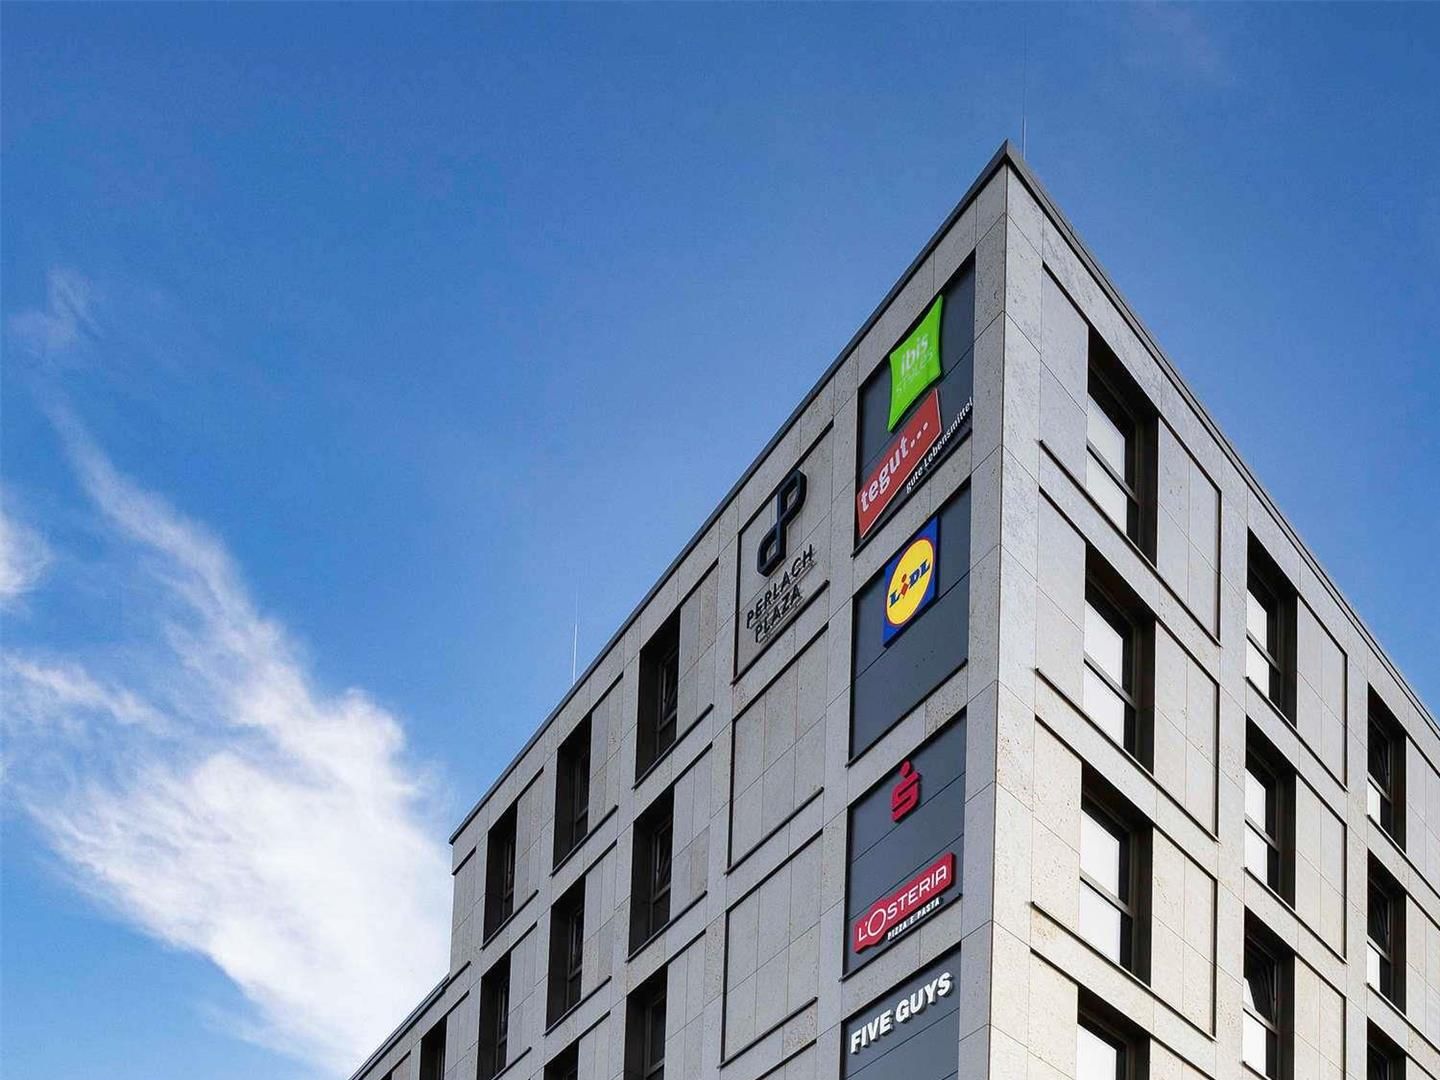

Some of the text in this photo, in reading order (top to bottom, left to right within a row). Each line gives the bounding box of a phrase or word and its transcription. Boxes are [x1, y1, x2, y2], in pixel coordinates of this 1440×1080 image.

[901, 334, 928, 376] ibis
[861, 422, 928, 512] tegut...
[906, 396, 973, 494] gute Lebensmittel
[747, 543, 813, 629] PERLACH
[755, 584, 801, 643] PLAZA
[858, 864, 947, 942] L'OSTERIA
[887, 920, 908, 941] PIZZA
[917, 897, 940, 919] PASTA
[850, 971, 953, 1055] FIVE GUYS
